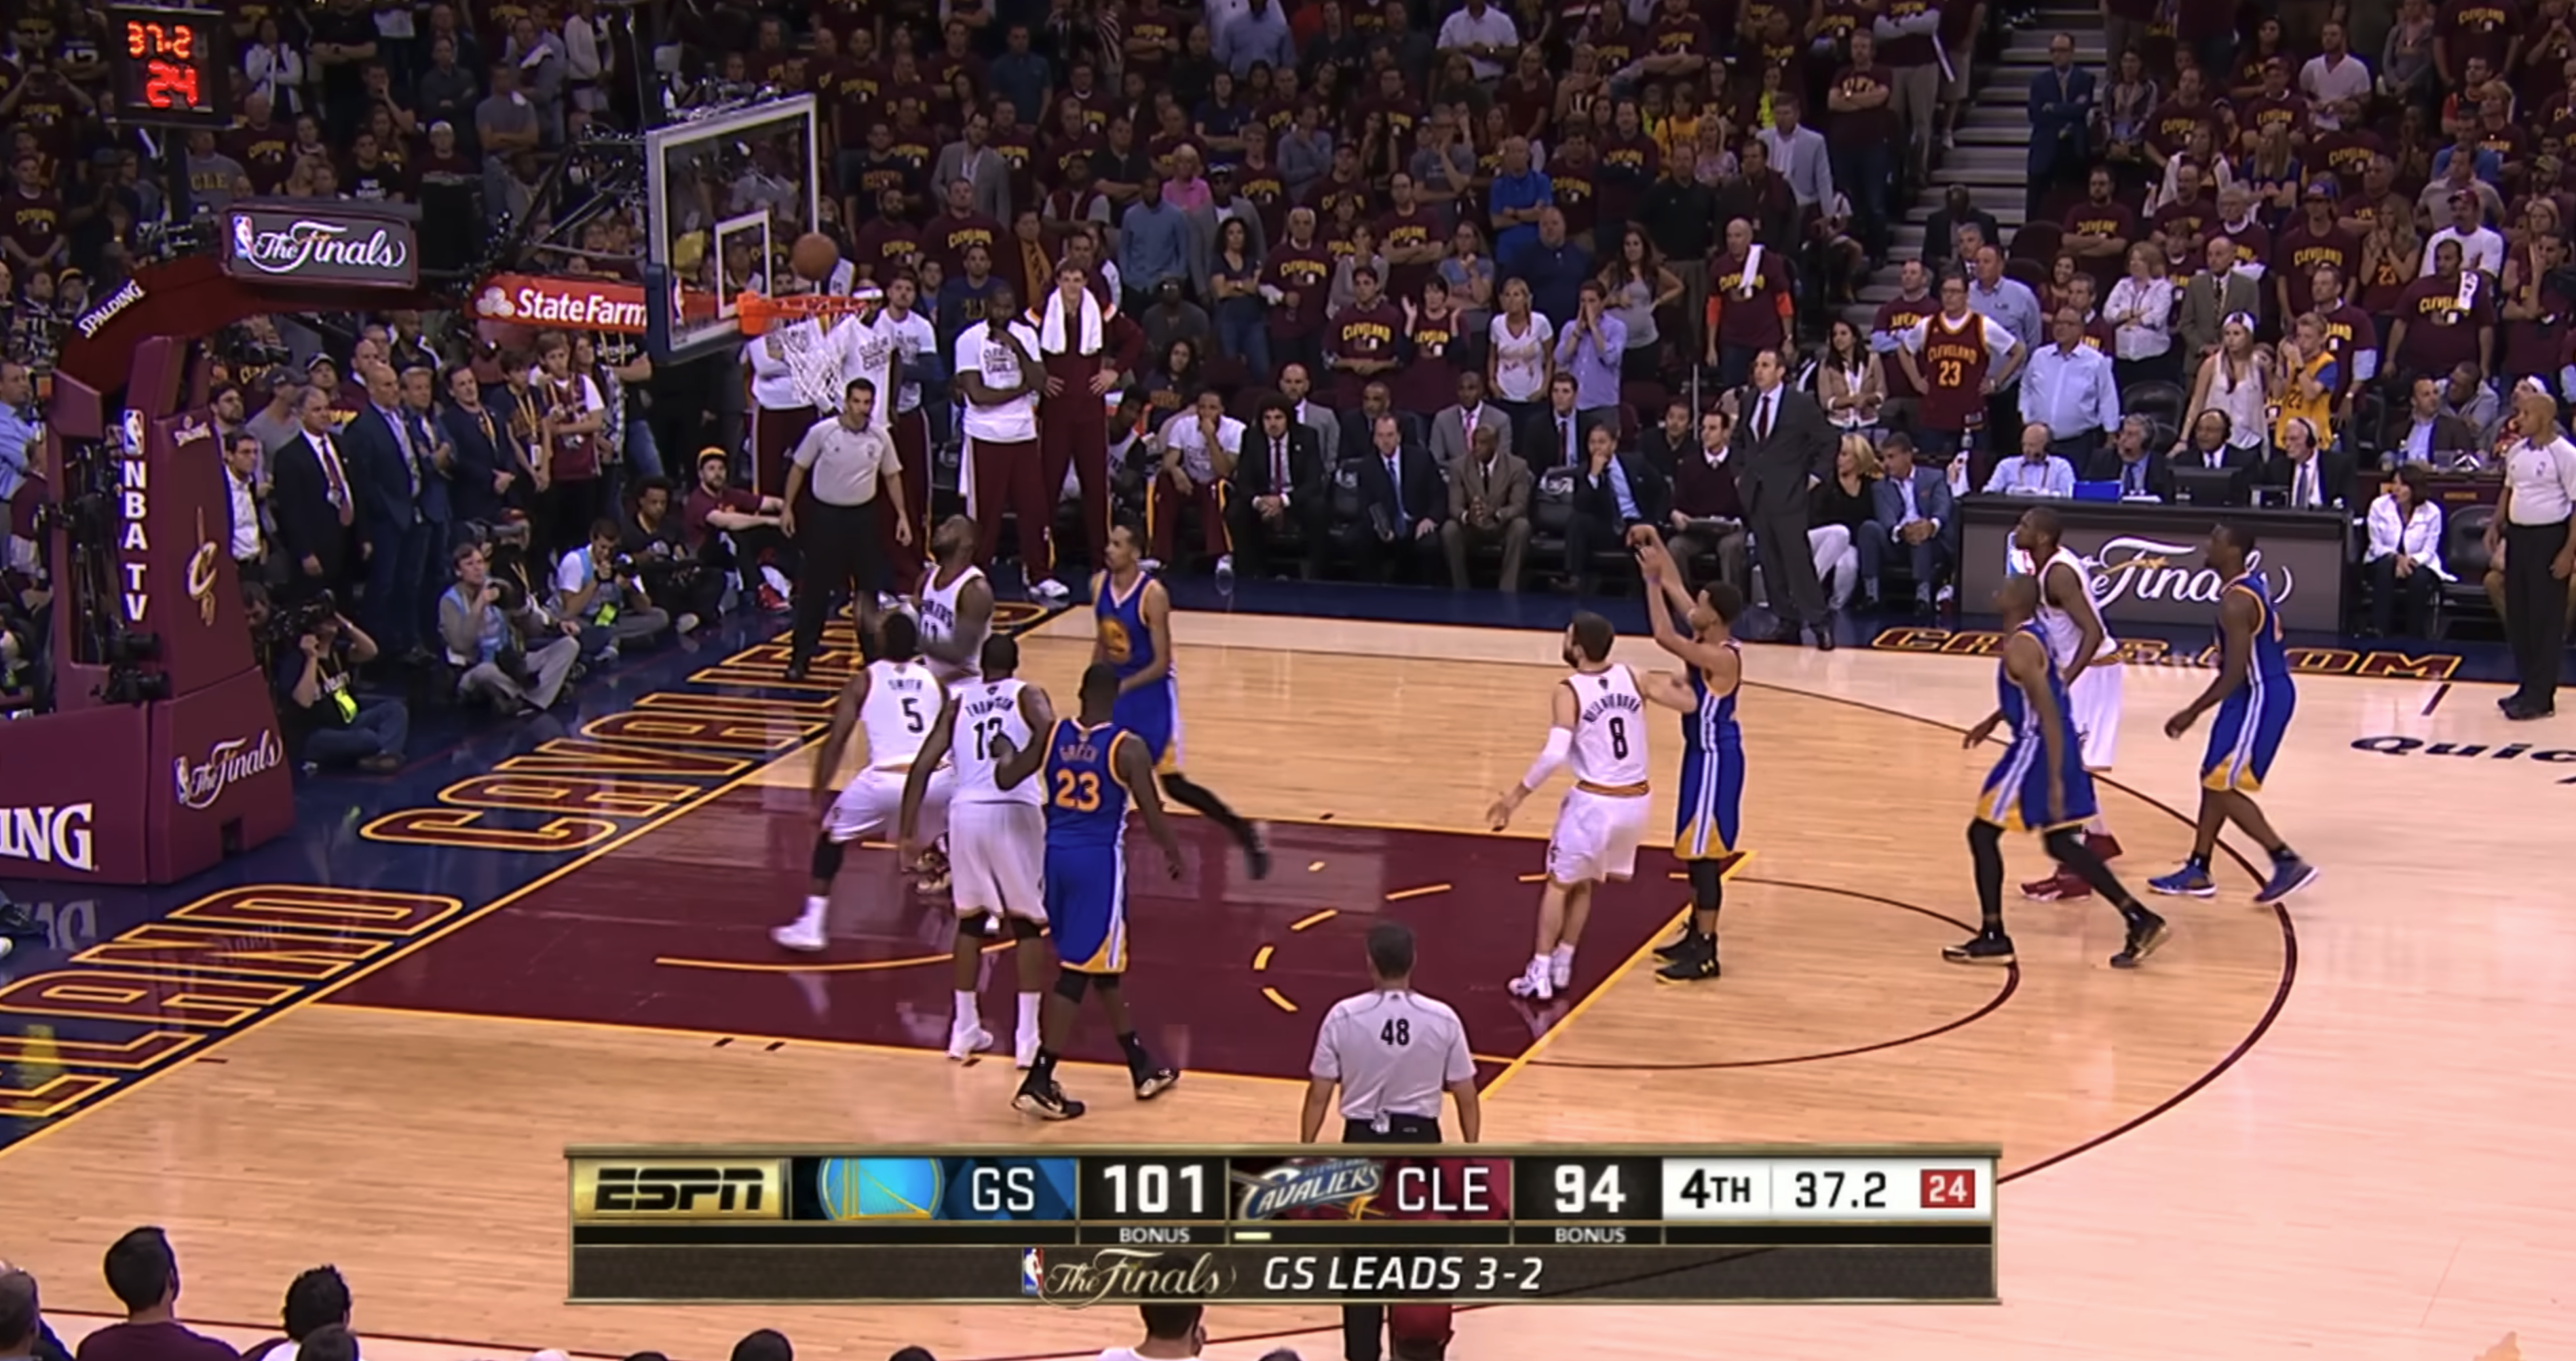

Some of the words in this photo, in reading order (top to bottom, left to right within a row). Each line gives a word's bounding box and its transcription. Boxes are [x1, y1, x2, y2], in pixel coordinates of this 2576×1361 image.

[126, 21, 193, 58] 37.2
[147, 60, 197, 107] 24
[285, 221, 393, 269] Finals
[78, 279, 147, 339] SPALDING
[1927, 345, 1977, 365] CLEVELAND
[1938, 361, 1962, 387] 23
[360, 600, 1048, 852] CAVALIES
[901, 697, 923, 733] 5
[1608, 716, 1628, 760] 8
[1055, 768, 1100, 812] 23
[1380, 1018, 1410, 1046] 48
